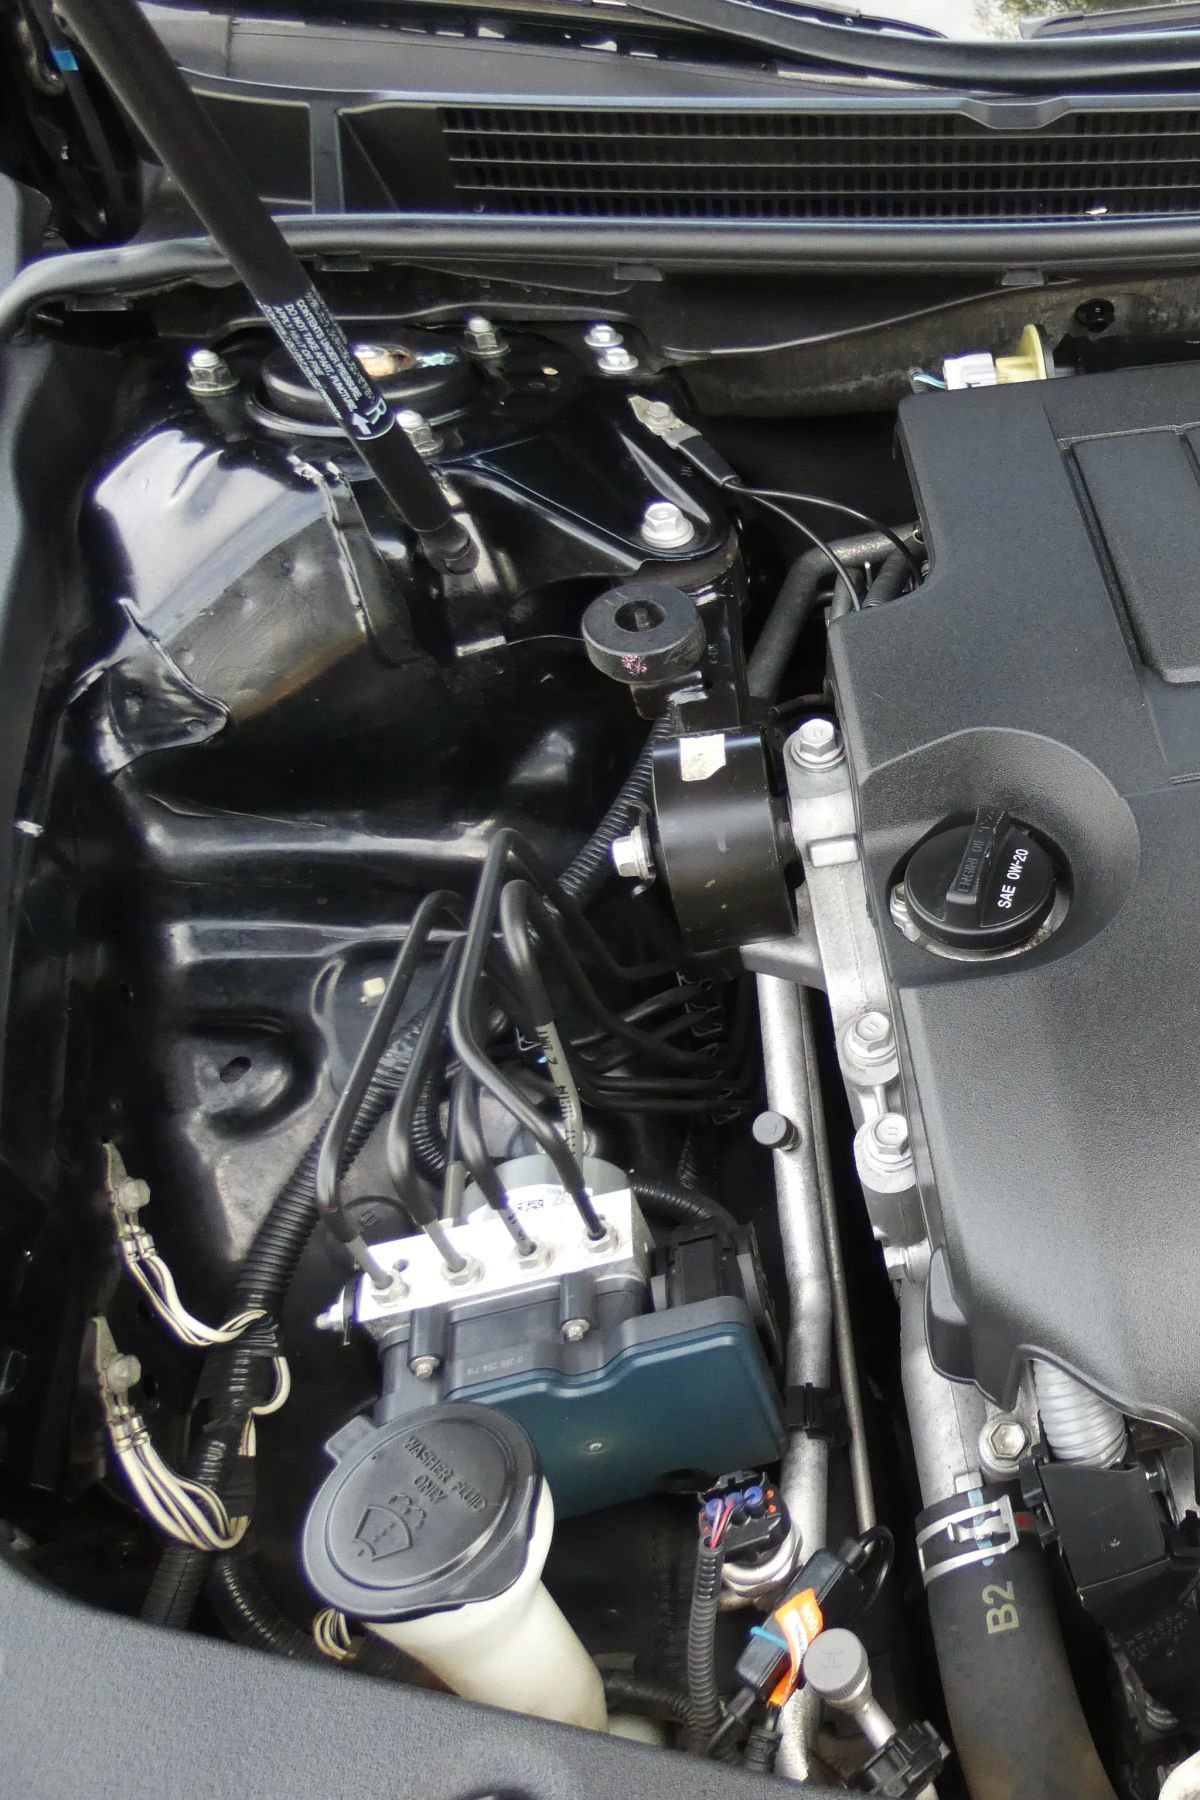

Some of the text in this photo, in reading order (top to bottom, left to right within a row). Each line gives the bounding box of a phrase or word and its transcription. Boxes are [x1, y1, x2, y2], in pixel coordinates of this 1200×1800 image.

[997, 848, 1029, 909] SAE 0W-20
[403, 1436, 487, 1511] WASHER FLUID
[413, 1474, 448, 1503] ONLY
[982, 1580, 1019, 1634] B2
